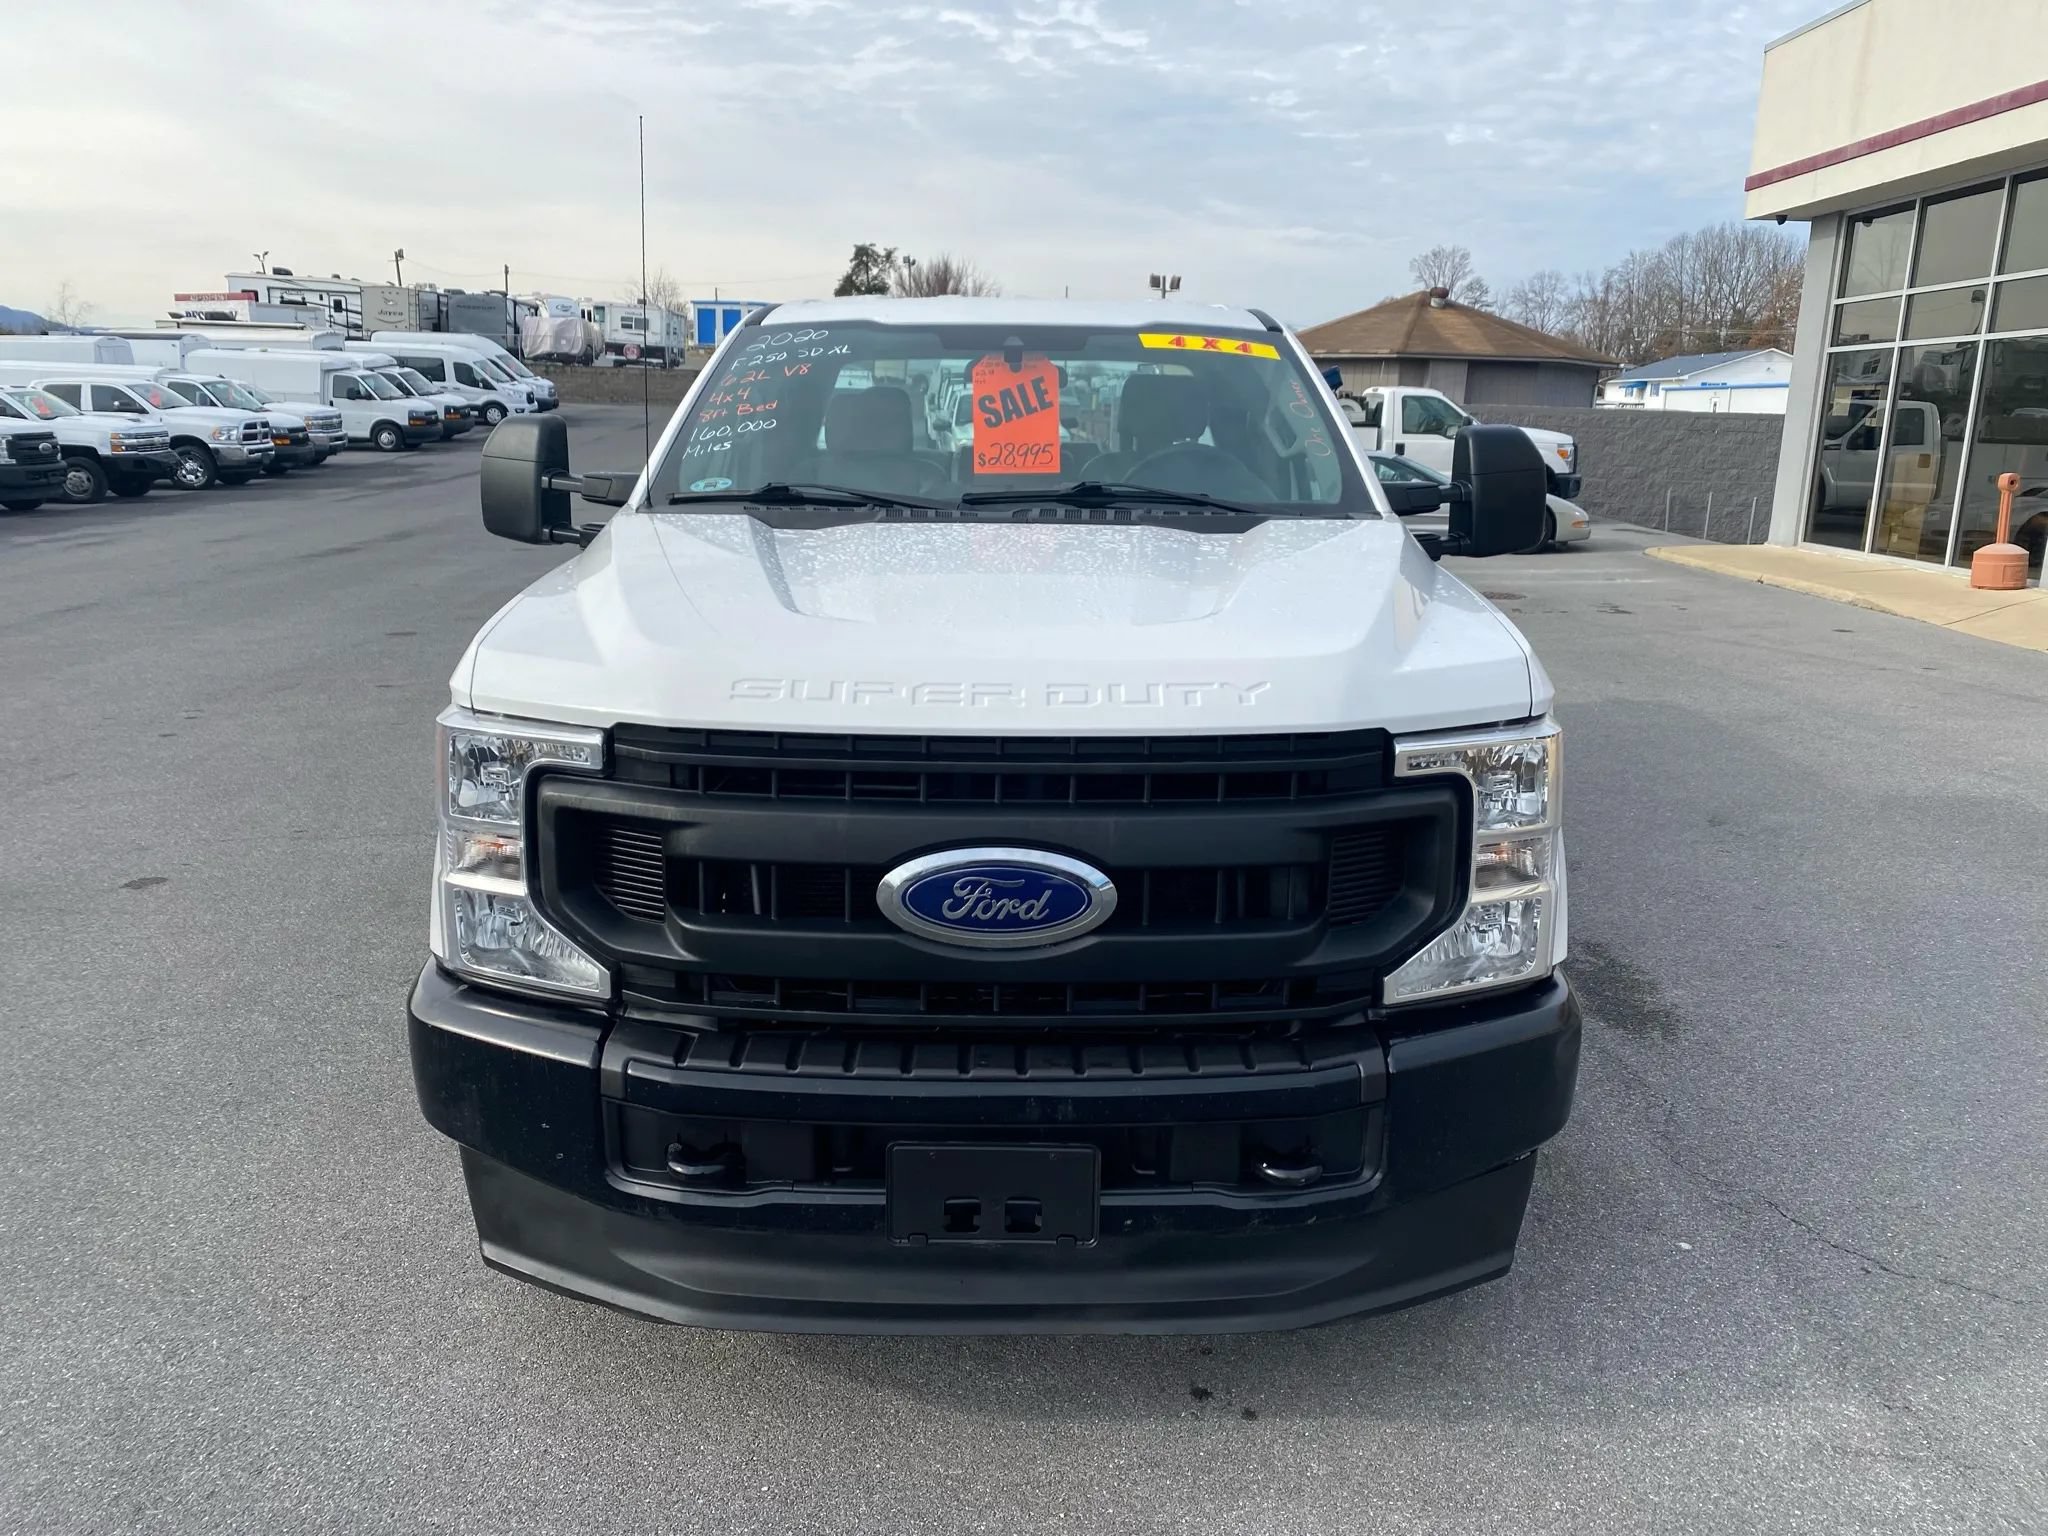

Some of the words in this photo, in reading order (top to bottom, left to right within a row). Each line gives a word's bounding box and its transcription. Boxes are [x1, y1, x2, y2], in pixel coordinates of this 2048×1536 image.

[746, 328, 829, 352] 2020
[827, 344, 852, 355] XL
[784, 362, 813, 377] V8
[736, 400, 778, 416] Bed
[978, 375, 1054, 429] SALE
[682, 440, 733, 460] Miles
[730, 678, 1026, 707] SUPER
[1046, 680, 1272, 707] DUTY
[941, 876, 1053, 920] Ford
